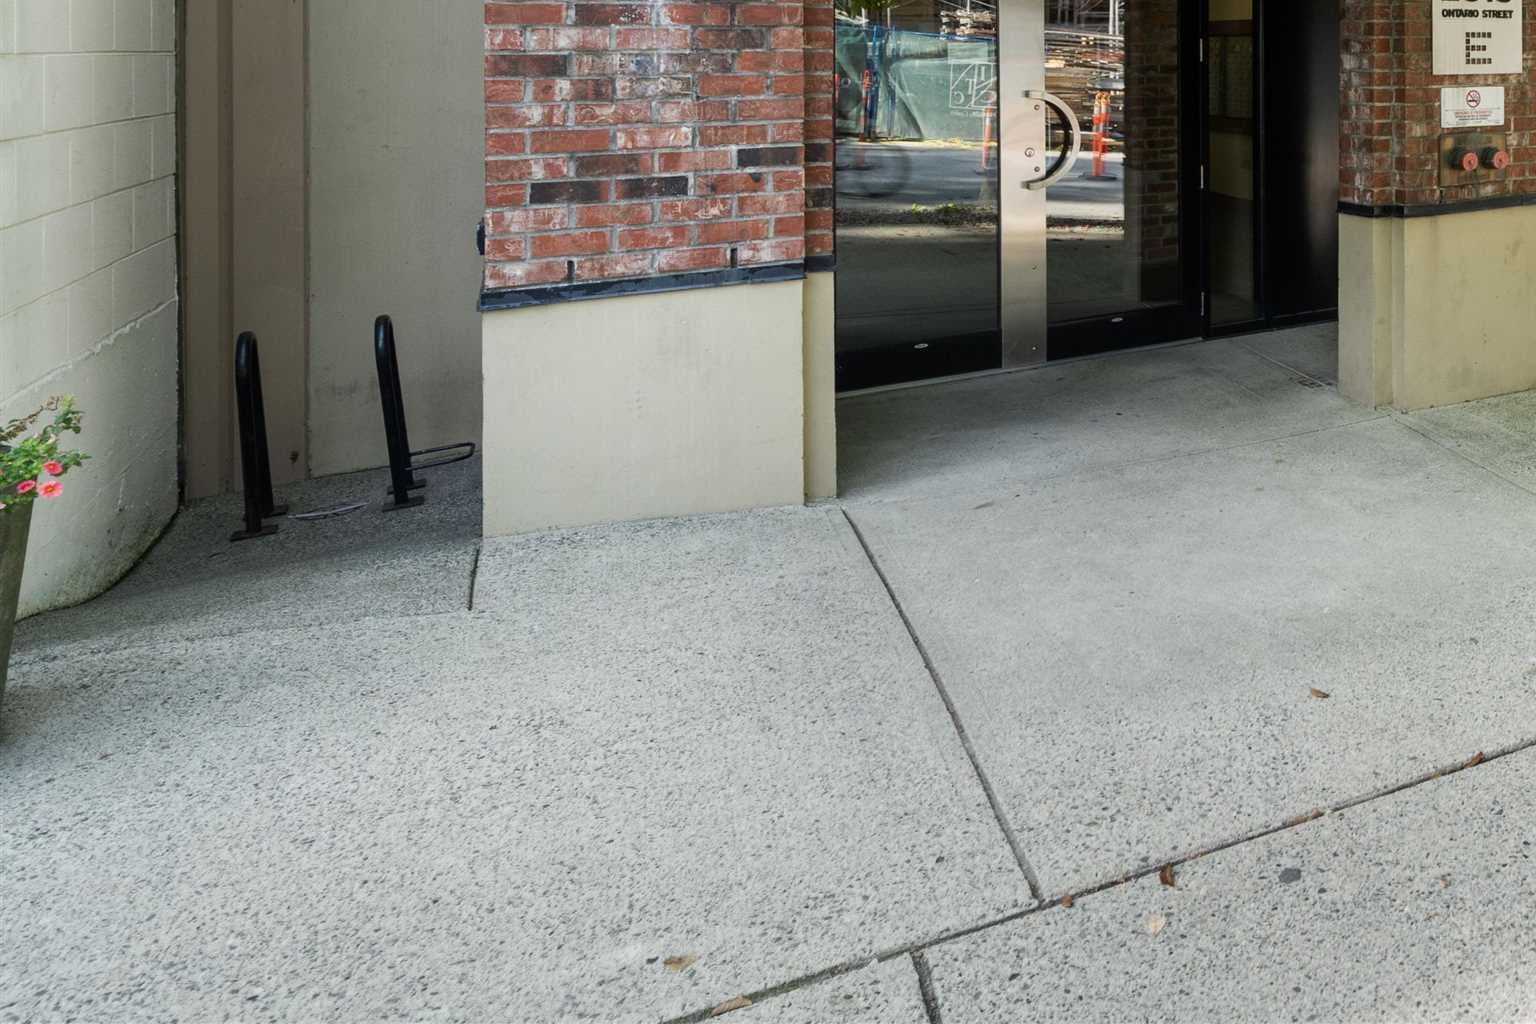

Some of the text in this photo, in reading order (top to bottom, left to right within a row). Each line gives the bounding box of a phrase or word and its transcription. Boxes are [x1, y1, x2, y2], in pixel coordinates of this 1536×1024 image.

[1441, 8, 1514, 18] ONTARIO STREET
[1465, 32, 1492, 64] E
